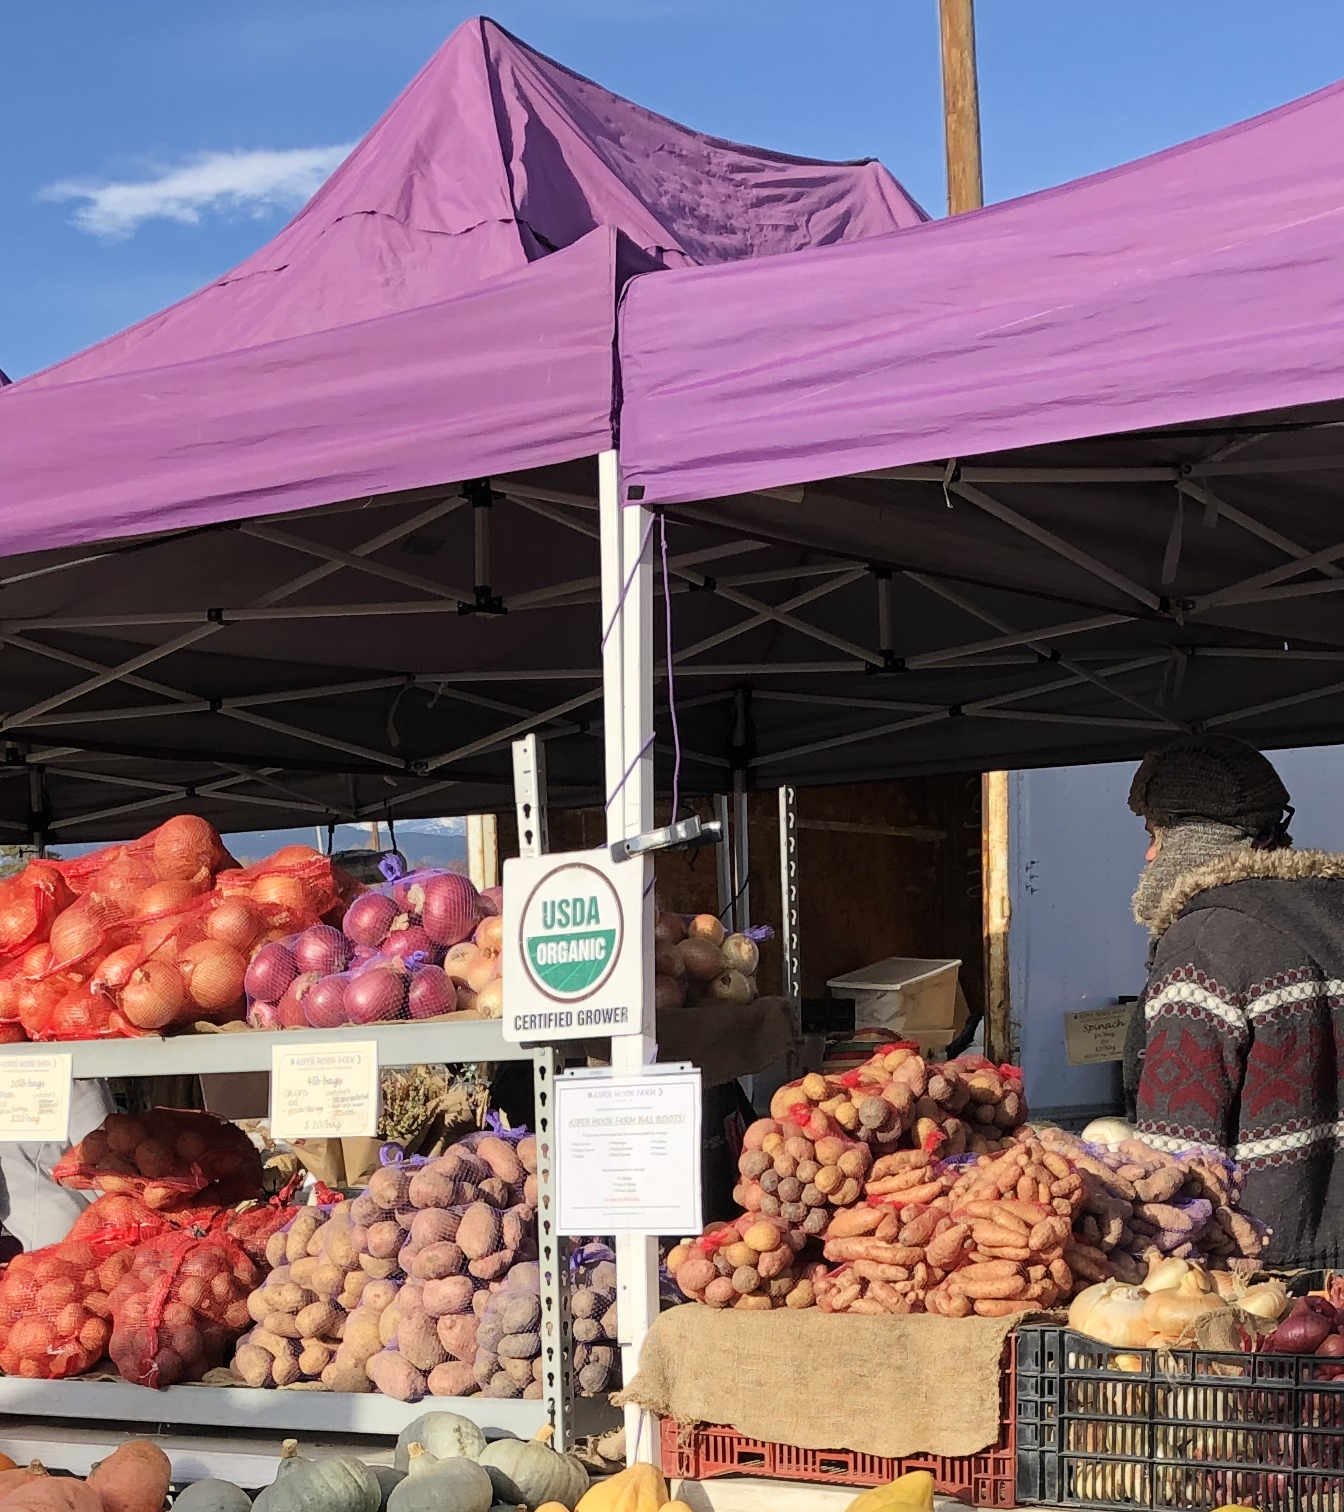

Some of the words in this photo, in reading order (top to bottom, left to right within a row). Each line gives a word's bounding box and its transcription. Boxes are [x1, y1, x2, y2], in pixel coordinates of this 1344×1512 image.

[541, 895, 601, 931] USDA
[536, 936, 607, 966] ORGANIC
[513, 1009, 574, 1032] CERTIFIED
[576, 1005, 629, 1027] GROWER
[1083, 1018, 1125, 1034] Spinach
[322, 1075, 344, 1089] bags
[637, 1115, 655, 1124] HAS
